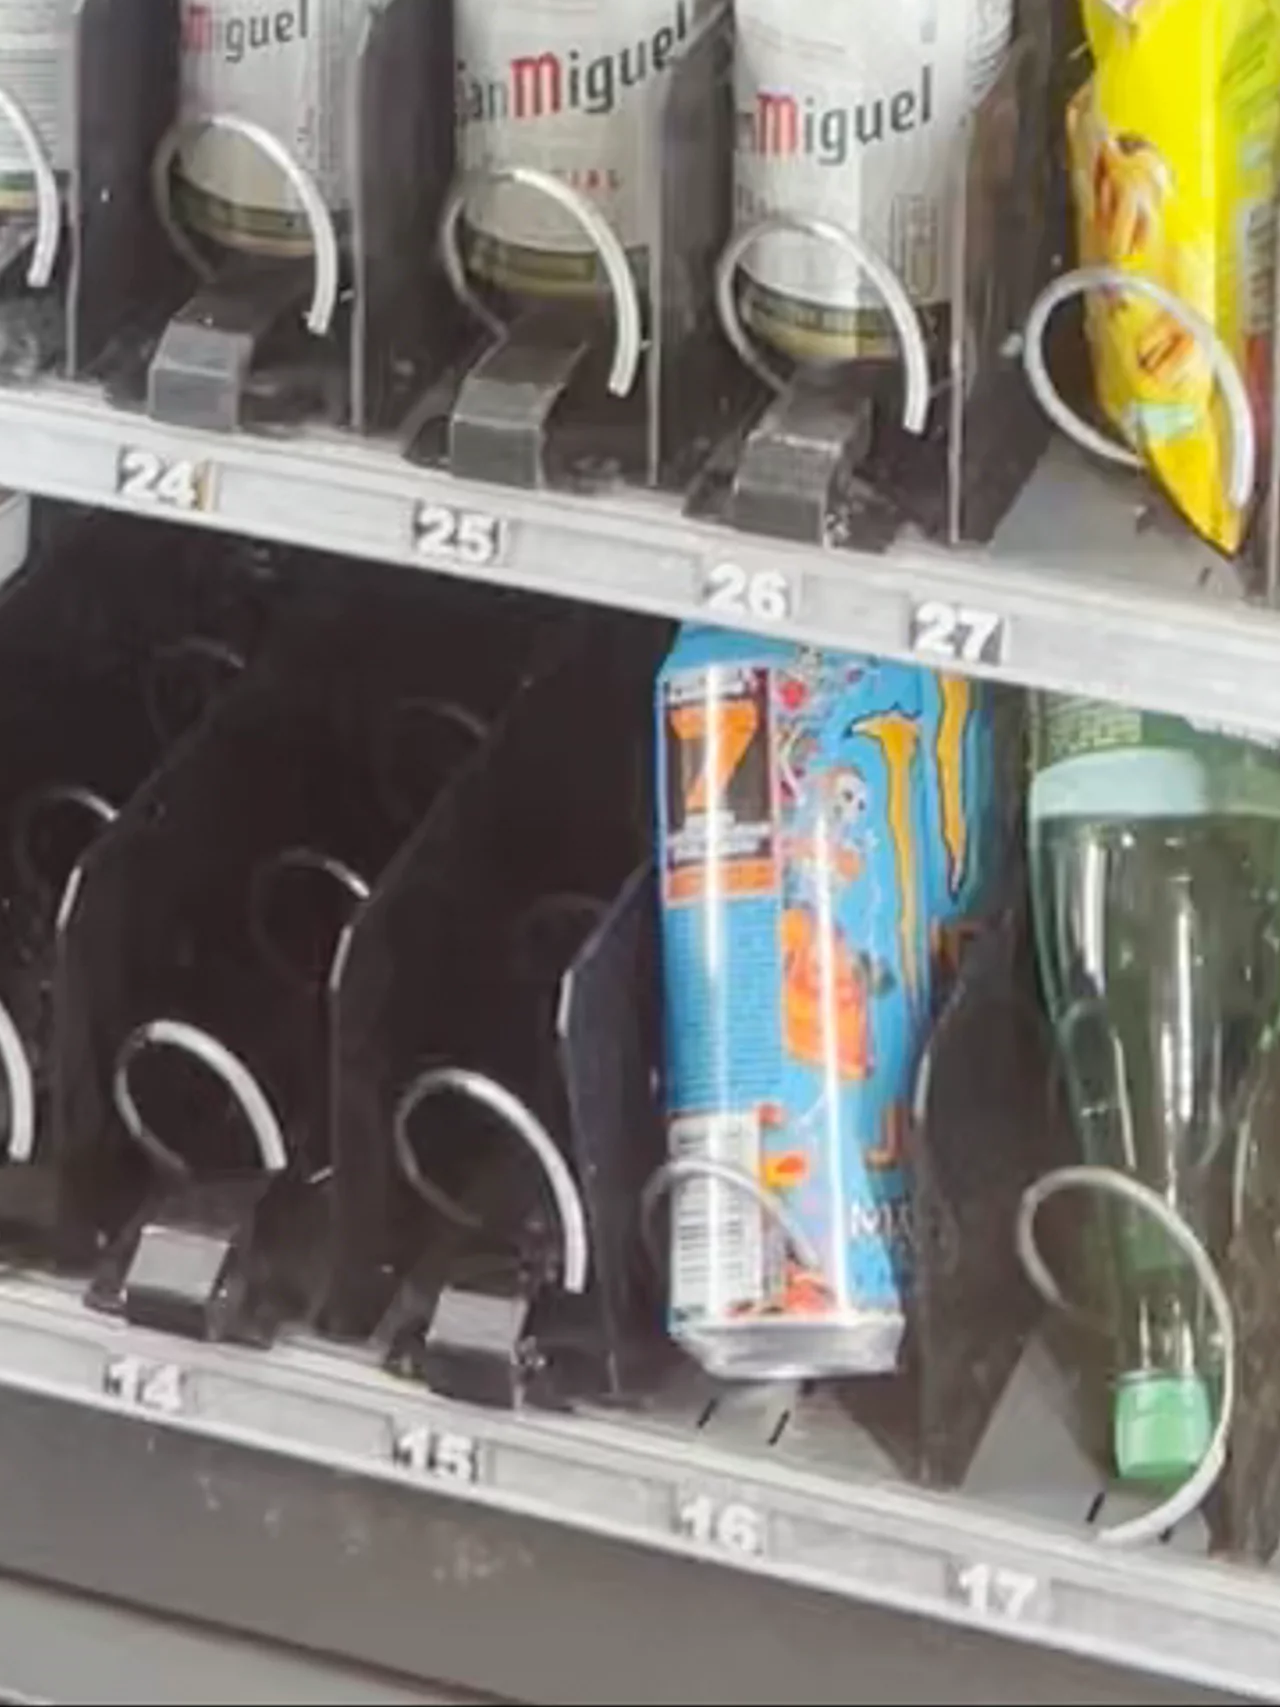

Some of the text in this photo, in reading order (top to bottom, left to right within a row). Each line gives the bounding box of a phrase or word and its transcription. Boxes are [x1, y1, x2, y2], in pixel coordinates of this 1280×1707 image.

[118, 449, 199, 508] 24
[411, 506, 493, 561] 25
[706, 565, 790, 621] 26
[914, 604, 1001, 660] 27
[106, 1360, 186, 1413] 14
[395, 1426, 479, 1479] 15
[682, 1495, 762, 1556] 16
[957, 1562, 1037, 1620] 17
